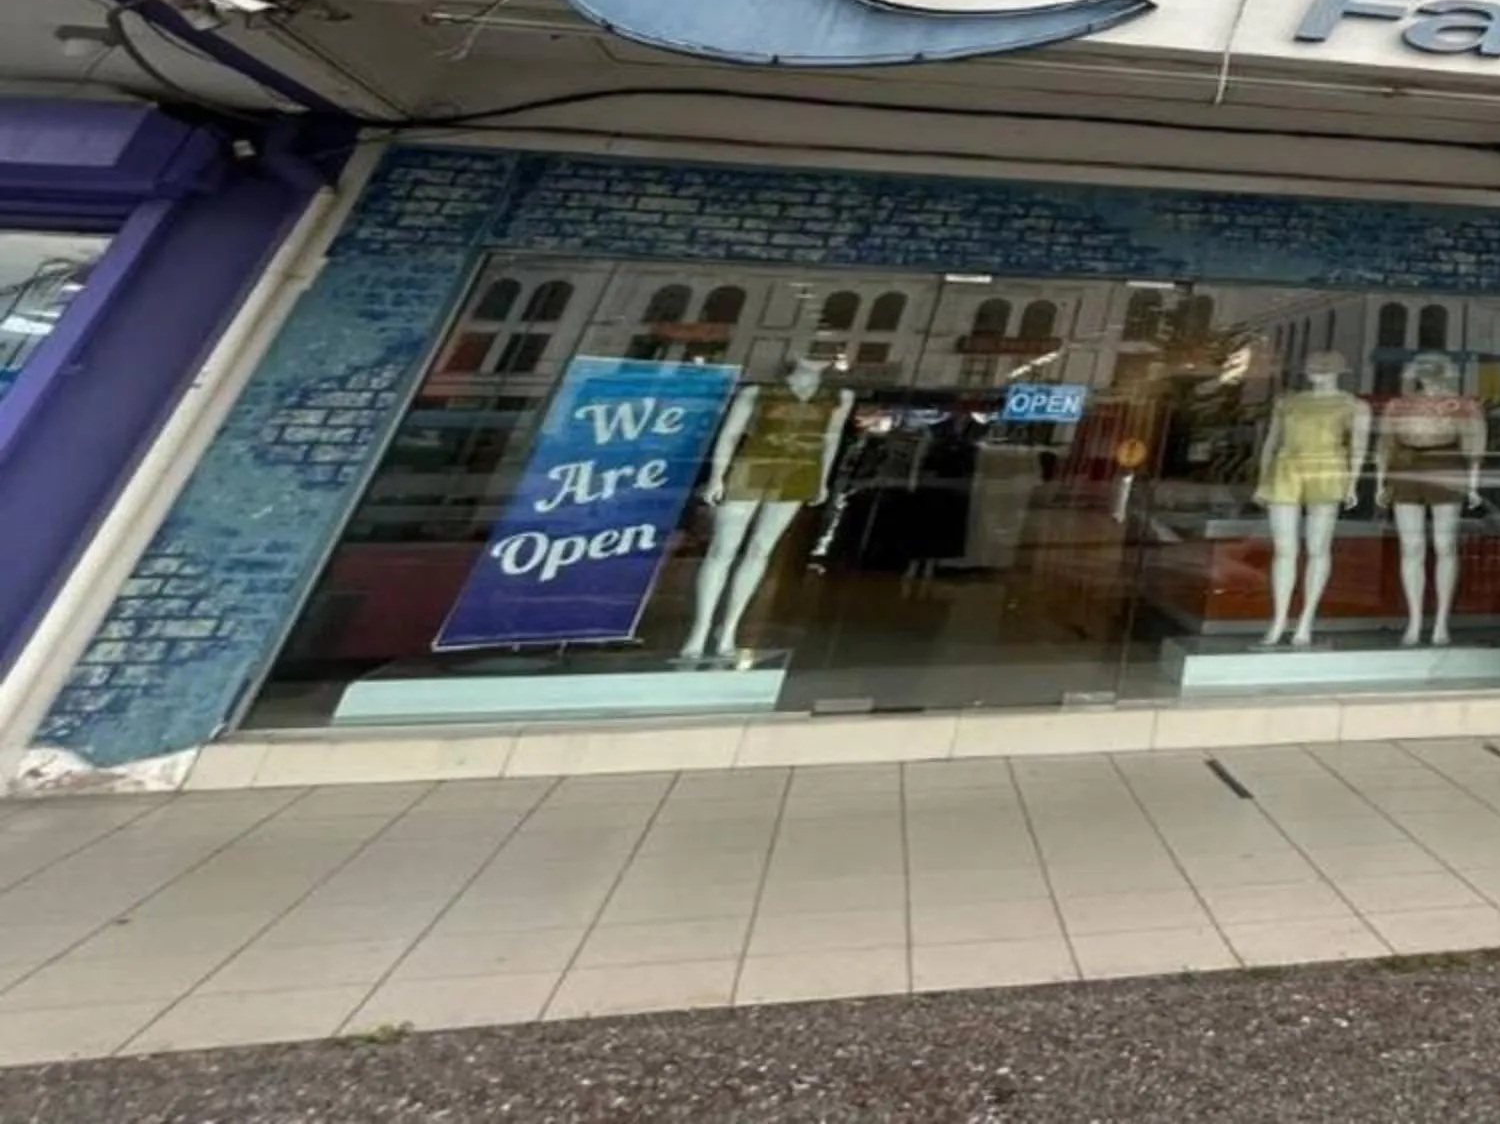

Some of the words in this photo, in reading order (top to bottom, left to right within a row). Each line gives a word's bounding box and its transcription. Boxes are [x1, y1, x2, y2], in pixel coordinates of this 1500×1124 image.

[574, 396, 686, 445] We
[1009, 393, 1080, 414] OPEN
[533, 458, 669, 512] Are
[490, 523, 657, 582] Open
